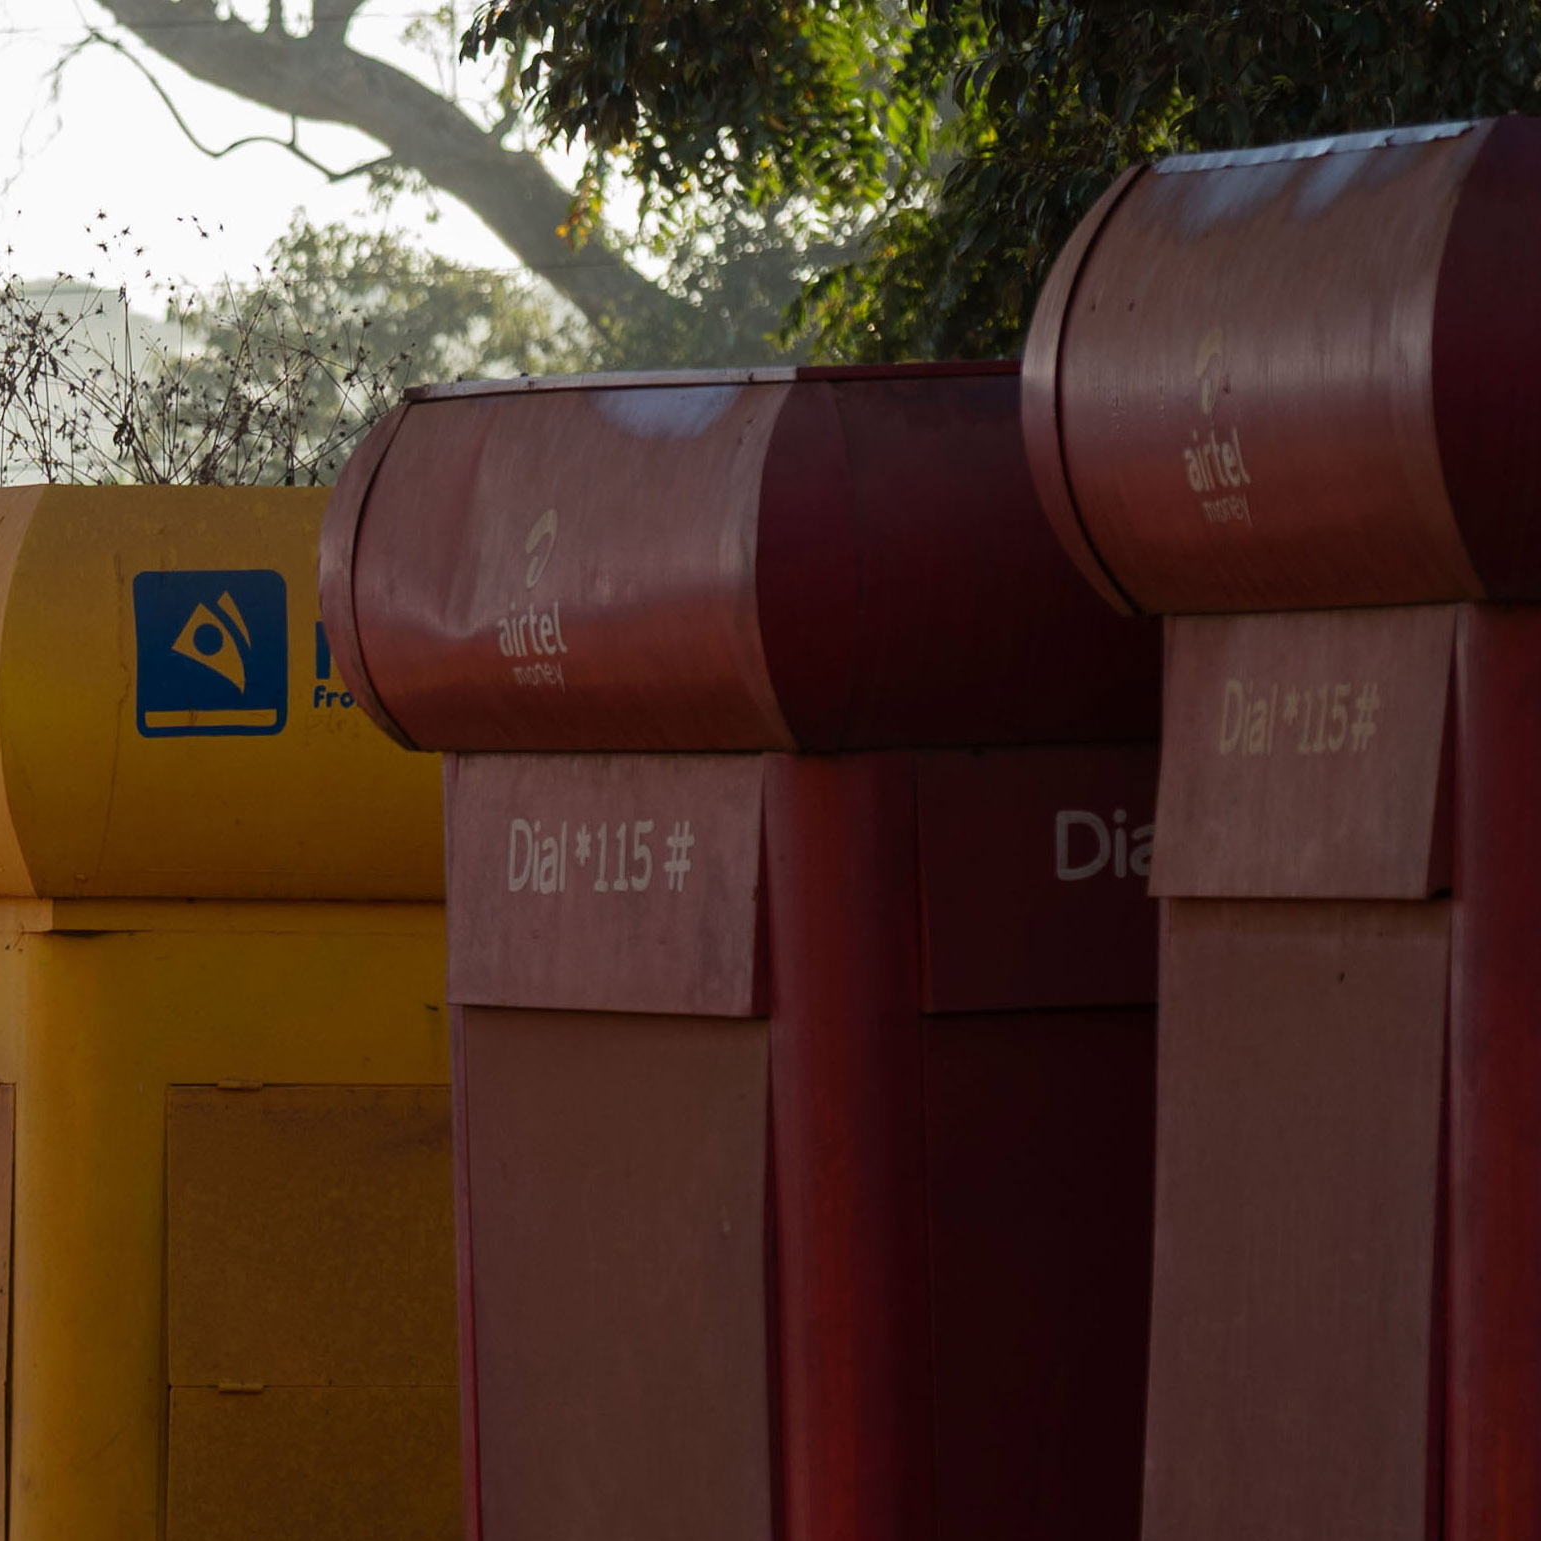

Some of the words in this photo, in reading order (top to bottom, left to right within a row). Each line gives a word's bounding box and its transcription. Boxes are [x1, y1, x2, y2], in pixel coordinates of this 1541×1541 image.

[1183, 426, 1251, 492] airtel
[1202, 493, 1253, 528] money
[497, 599, 568, 657] airtel
[513, 661, 566, 694] money
[1219, 680, 1279, 758] Dial
[507, 817, 568, 896] Dial
[1056, 808, 1155, 880] Dia
